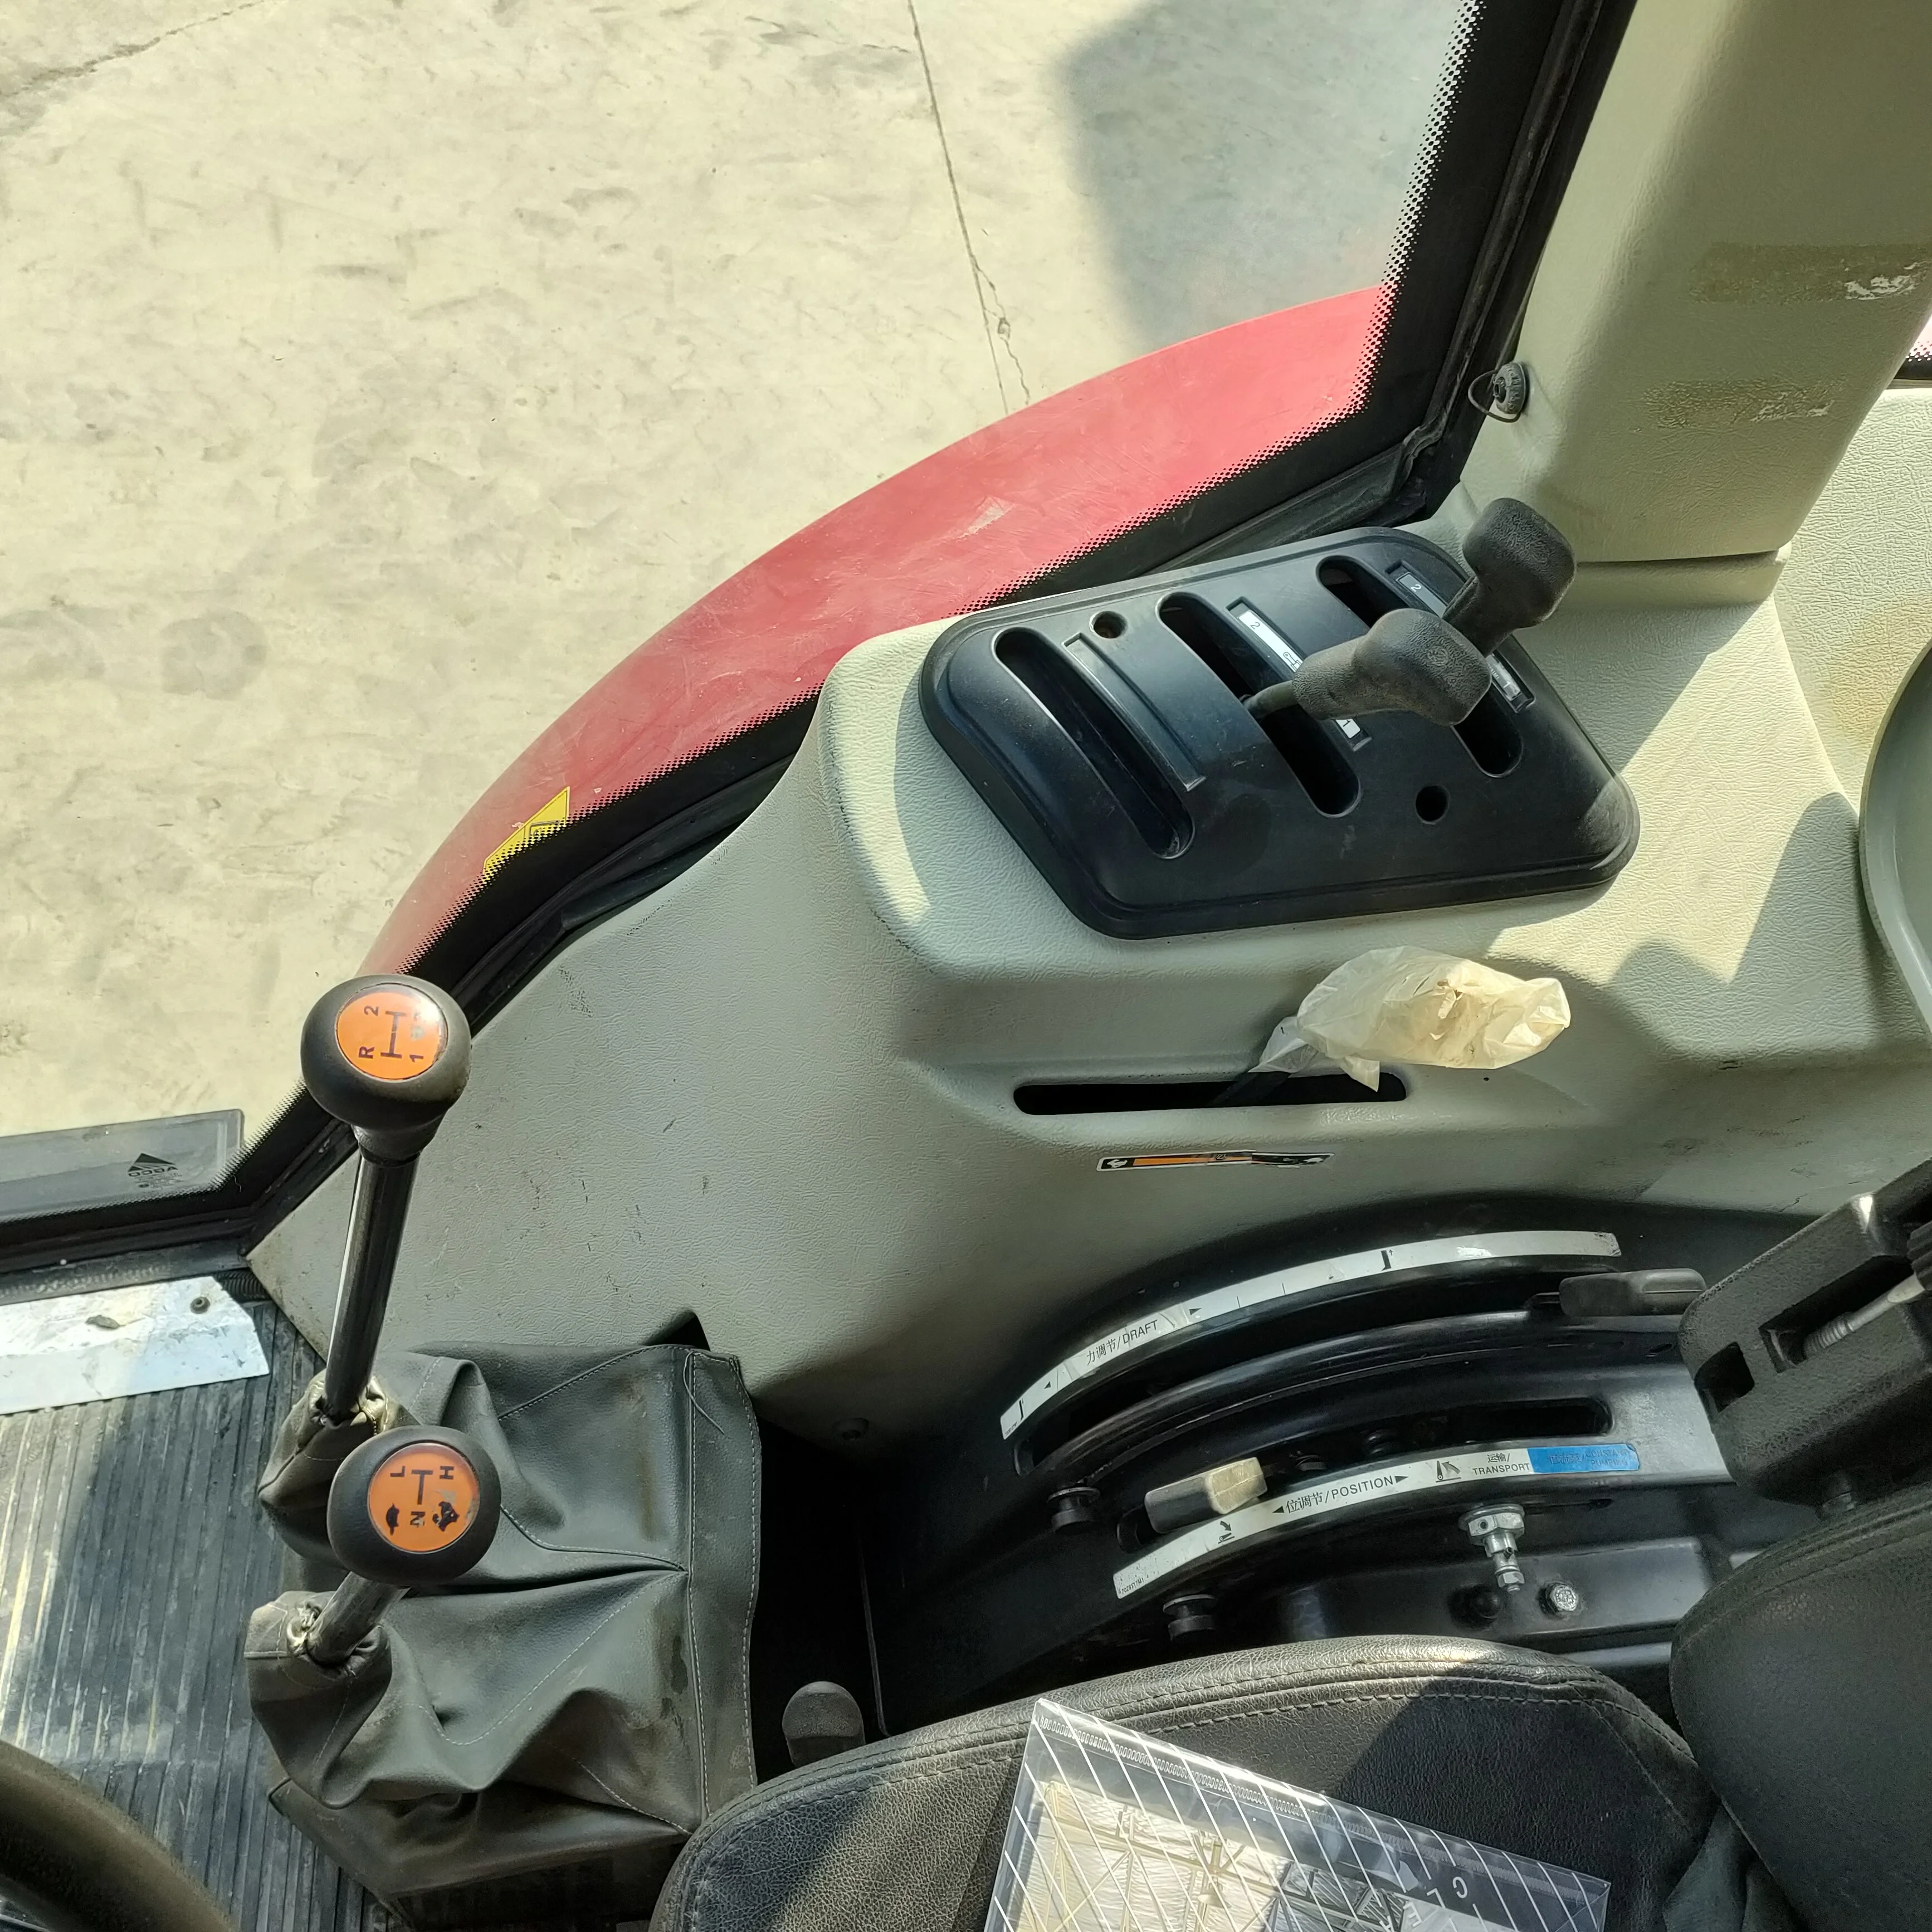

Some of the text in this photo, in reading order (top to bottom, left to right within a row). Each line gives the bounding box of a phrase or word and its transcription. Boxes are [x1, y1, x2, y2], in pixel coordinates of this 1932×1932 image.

[1410, 584, 1422, 592] 2
[363, 1005, 379, 1017] 2
[358, 1046, 375, 1059] R
[409, 1054, 424, 1063] 1
[390, 1466, 406, 1477] L
[439, 1466, 455, 1480] H
[1472, 1463, 1530, 1476] TRANSPORT
